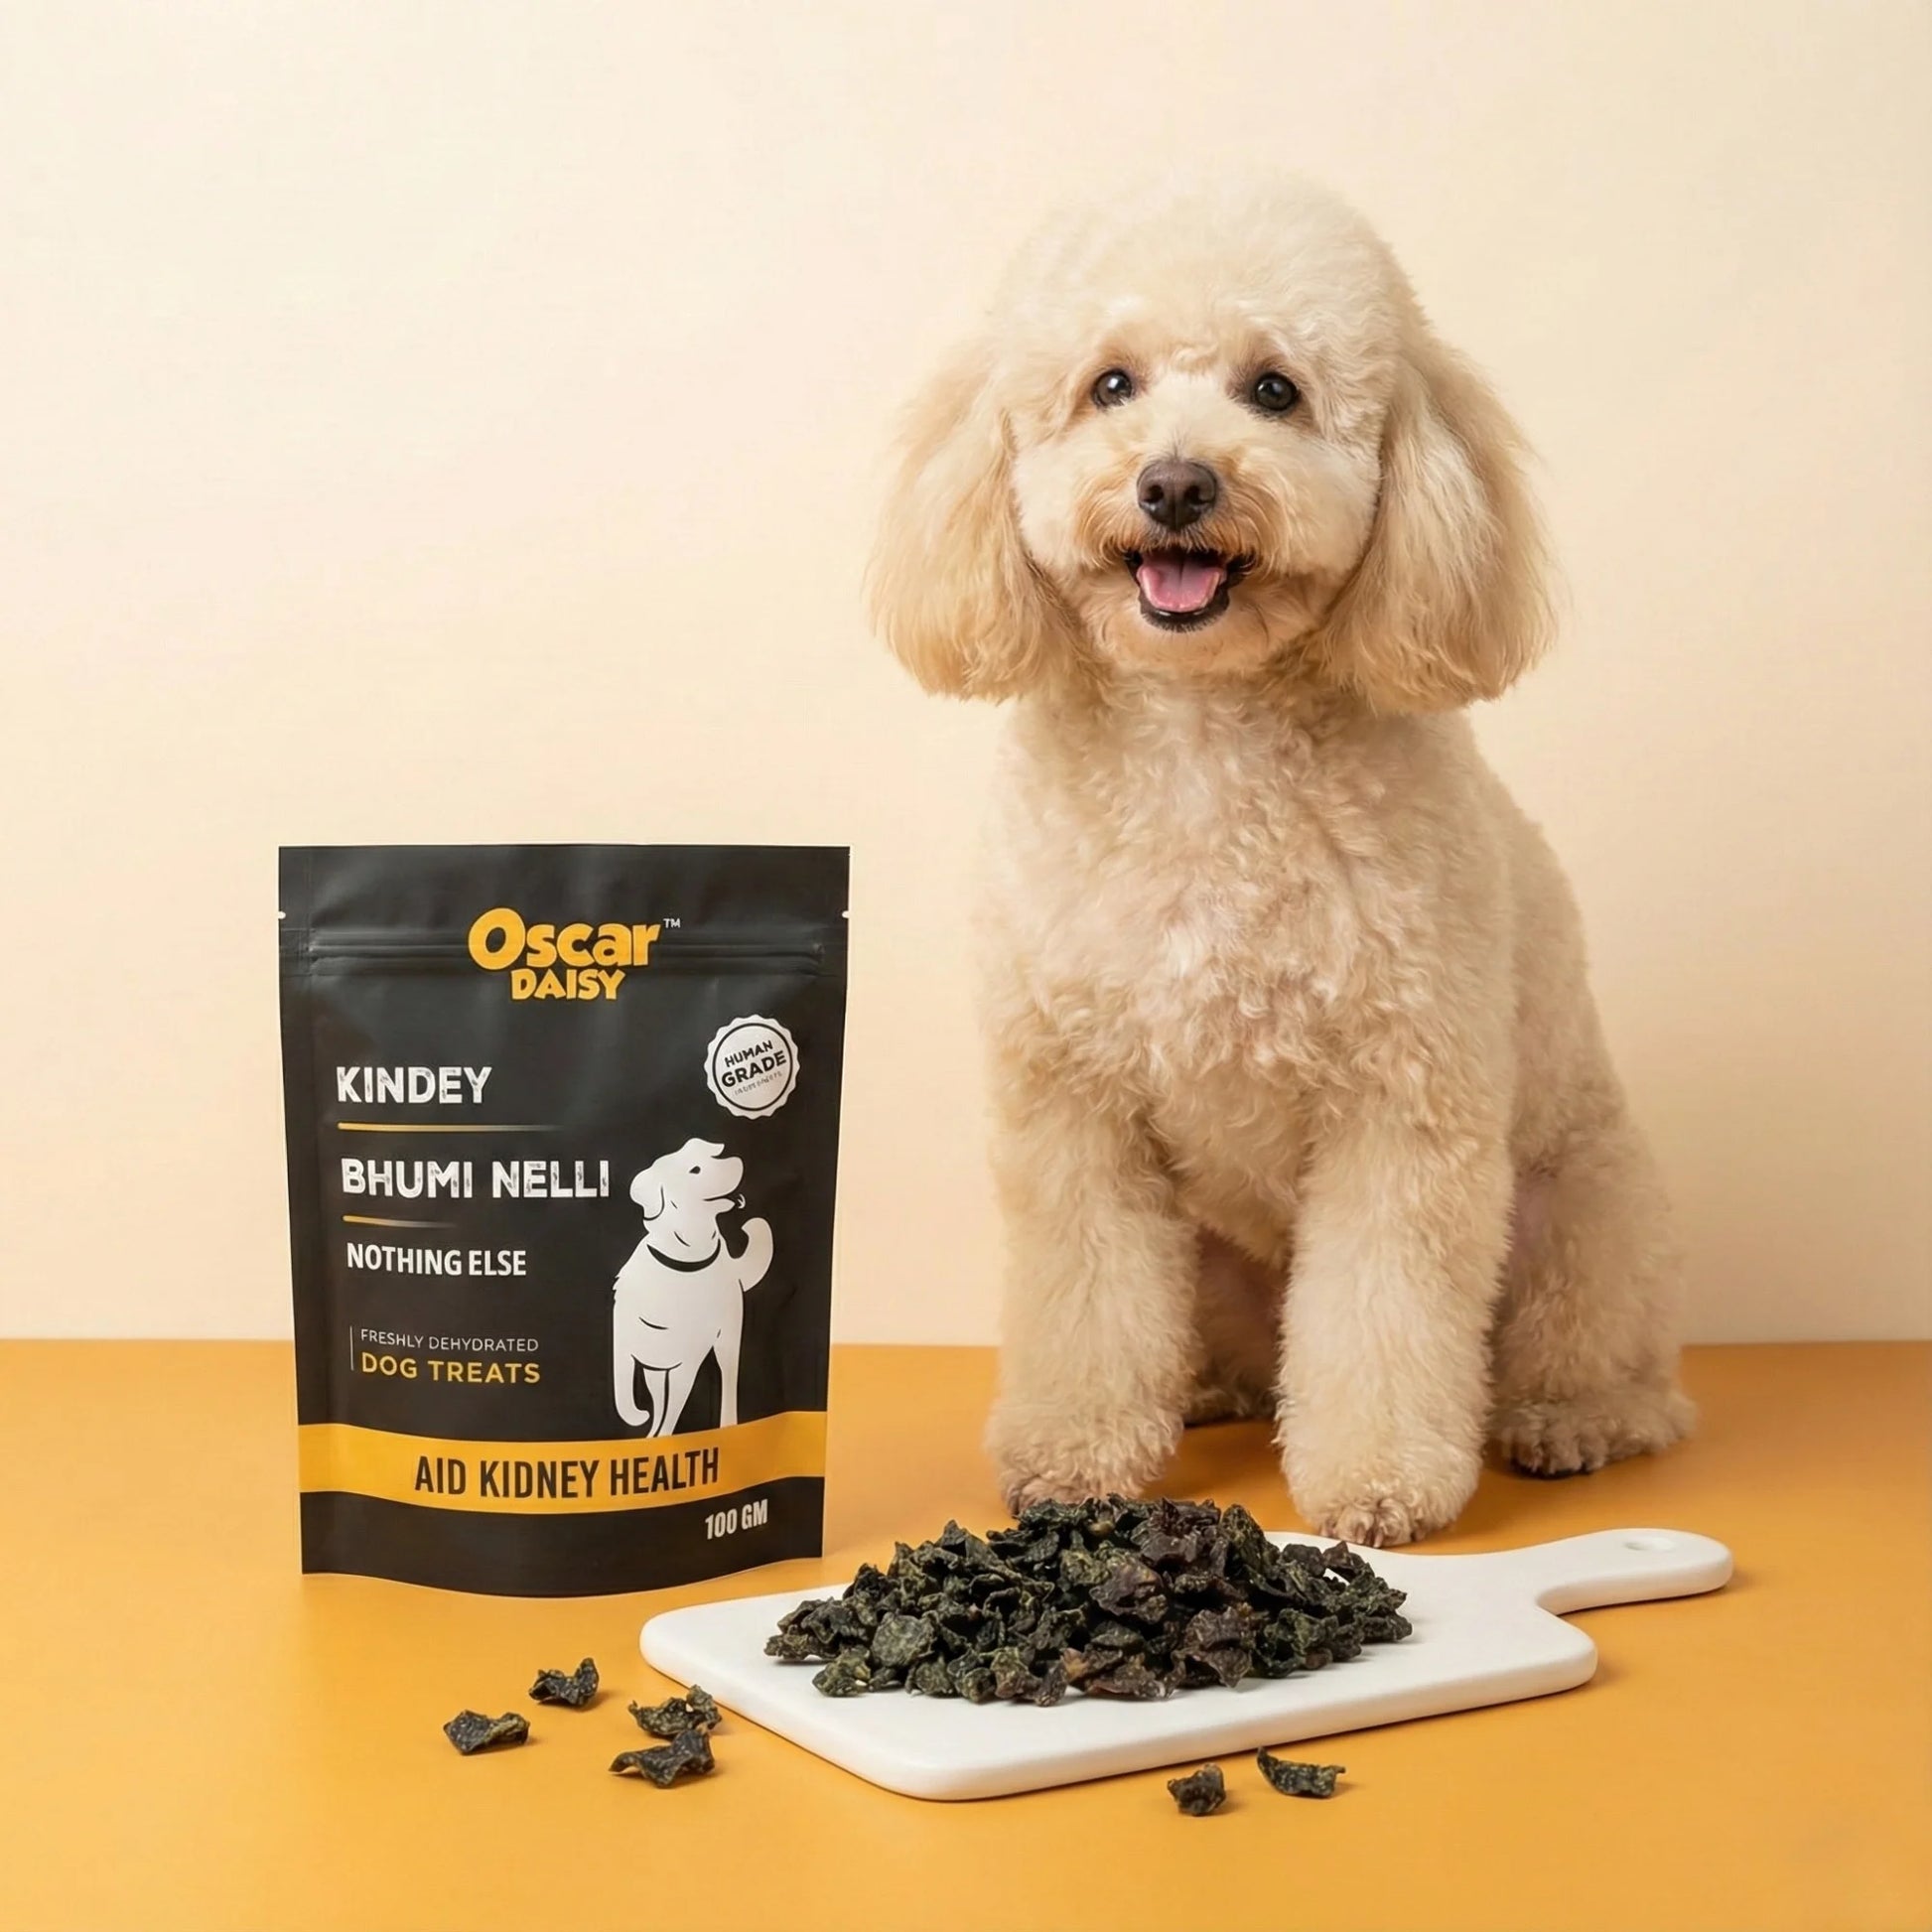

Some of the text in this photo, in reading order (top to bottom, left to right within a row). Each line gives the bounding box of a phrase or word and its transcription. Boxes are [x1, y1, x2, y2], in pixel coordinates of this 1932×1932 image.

[468, 907, 661, 970] Oscar
[510, 969, 626, 1000] DAISY
[721, 1049, 787, 1088] GRADE
[724, 1039, 773, 1068] HUMAN
[337, 1066, 492, 1104] KINDEY
[342, 1159, 610, 1198] BHUMI NELLI
[347, 1242, 526, 1277] NOTHING ELSE
[360, 1328, 539, 1352] FRESHLY DEHYDRATED
[361, 1351, 541, 1384] DOG TREATS
[415, 1447, 720, 1499] AID KIDNEY HEALTH
[705, 1498, 768, 1540] 100 GM
